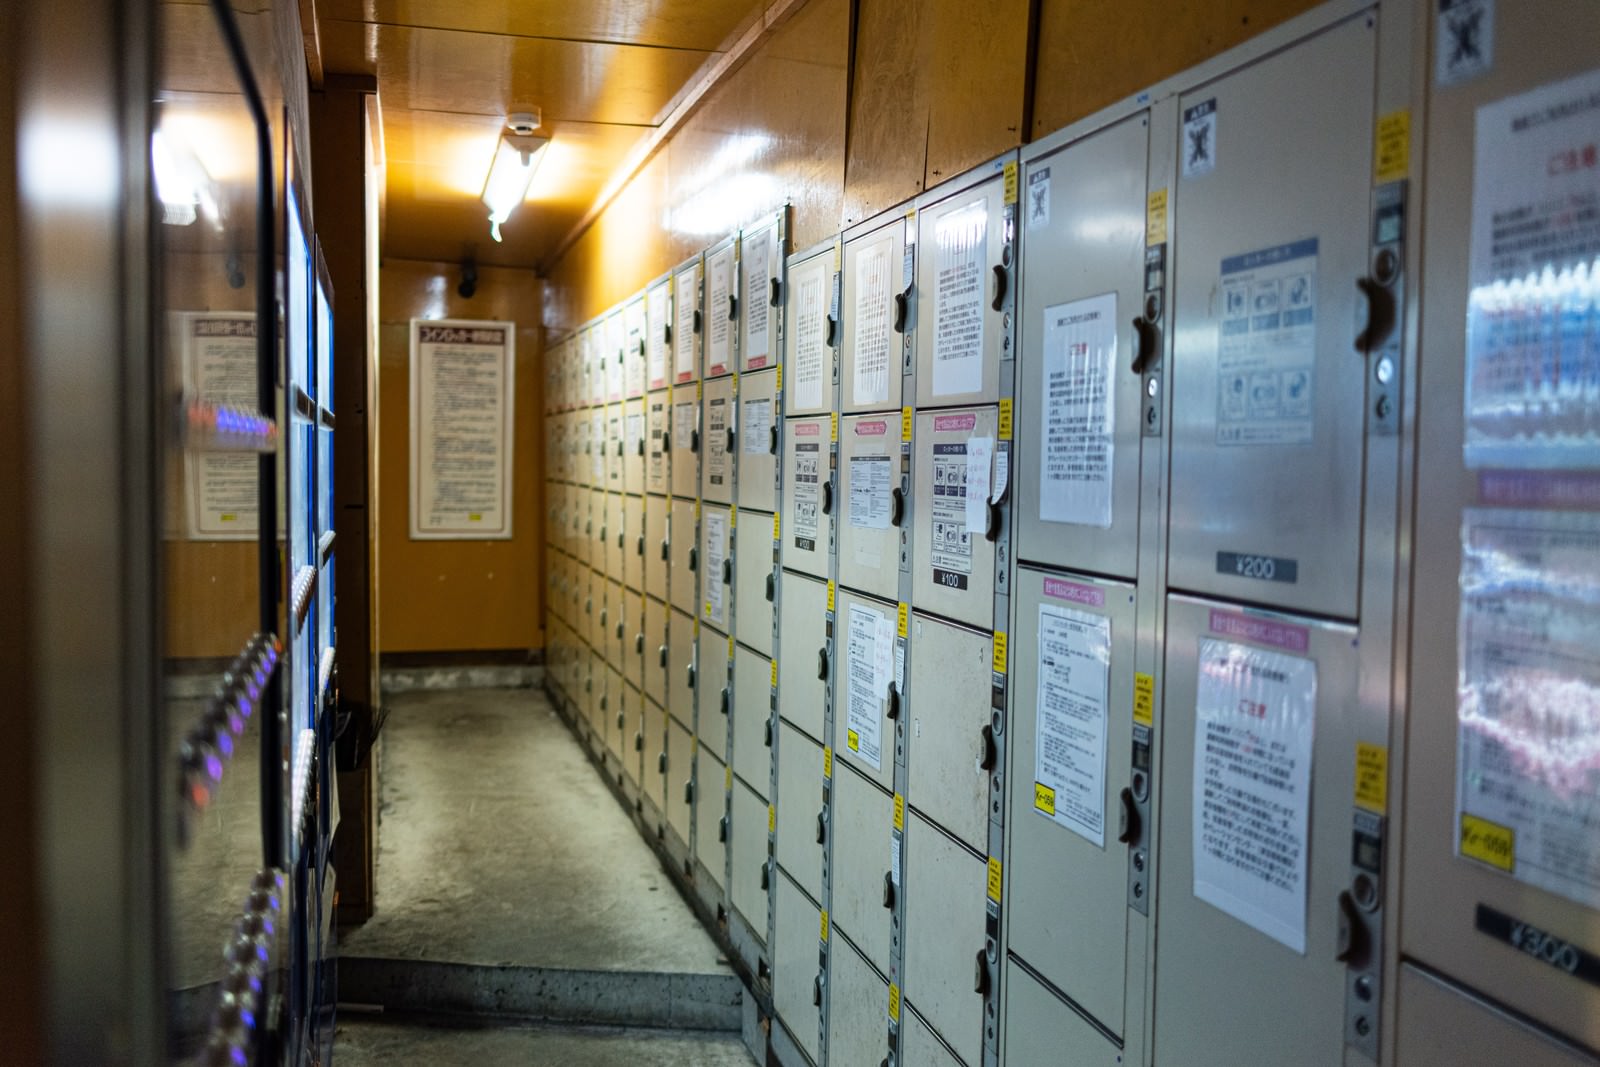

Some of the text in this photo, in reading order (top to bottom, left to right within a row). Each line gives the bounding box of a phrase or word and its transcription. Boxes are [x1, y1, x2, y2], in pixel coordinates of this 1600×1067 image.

[1236, 554, 1276, 578] ¥200
[941, 573, 959, 588] ¥100
[1509, 919, 1579, 976] ¥300
